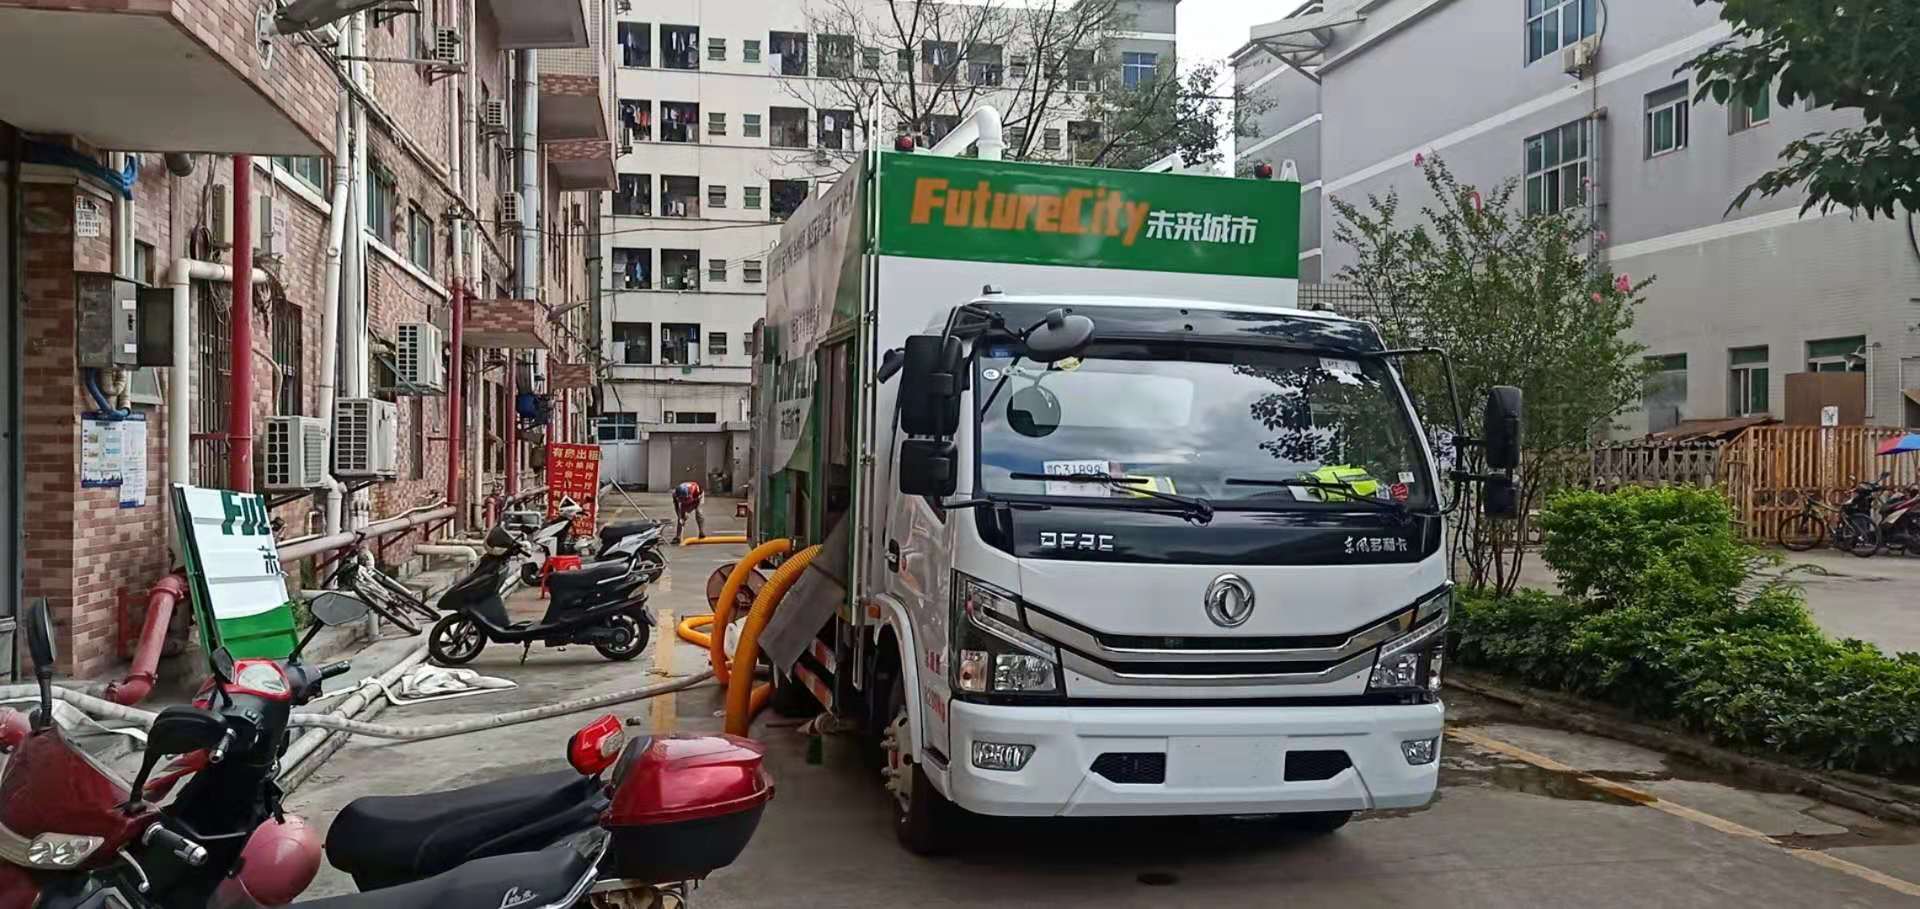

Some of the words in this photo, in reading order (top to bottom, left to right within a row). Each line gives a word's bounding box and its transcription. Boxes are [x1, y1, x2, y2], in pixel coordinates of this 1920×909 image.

[911, 177, 1149, 247] FutureCity
[1146, 210, 1258, 244] 未来城市
[552, 447, 601, 461] 有房出租
[1344, 536, 1408, 554] 东风多利卡
